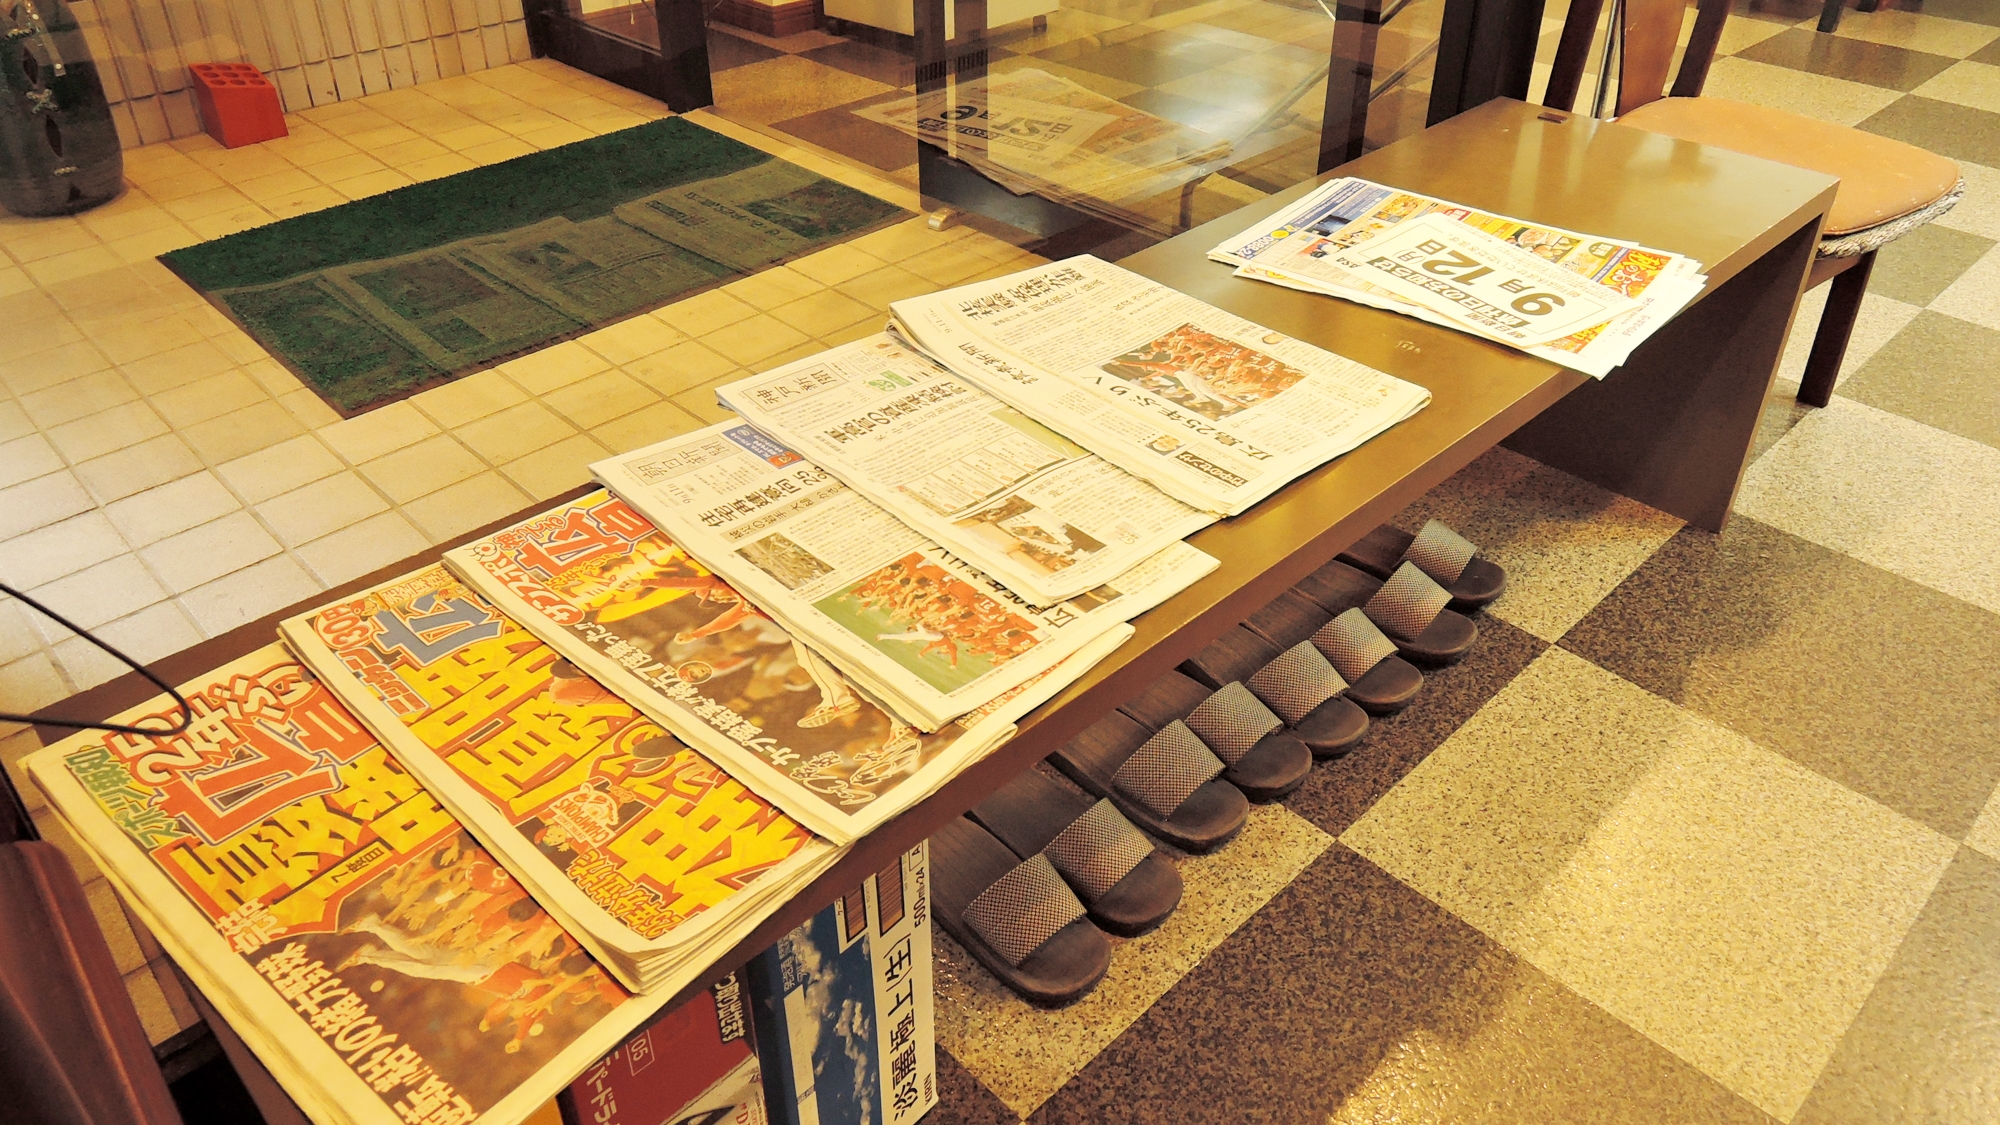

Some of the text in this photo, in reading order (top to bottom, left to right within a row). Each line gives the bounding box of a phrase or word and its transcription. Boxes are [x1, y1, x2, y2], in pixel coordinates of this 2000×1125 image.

[1334, 256, 1362, 269] ASA
[1412, 238, 1497, 286] 12日
[1371, 258, 1524, 326] 休刊日のお知らせ
[1496, 277, 1572, 318] 9月
[1462, 311, 1529, 339] 朝日新聞
[749, 368, 839, 405] 神戸新聞
[823, 380, 967, 443] 軍高官の資産凍結検討
[1078, 376, 1275, 463] 広島25年ぶりV
[637, 440, 729, 480] 朝日新聞
[694, 478, 802, 529] 住宅再建意向
[489, 512, 568, 550] 神ってる
[481, 556, 582, 624] サンスポ
[133, 663, 320, 785] 25年ぶり
[70, 743, 179, 849] スポーツ報知
[552, 799, 611, 843] CHAMPIONS
[330, 845, 387, 883] 7度目
[912, 846, 920, 857] A
[566, 849, 680, 939] 25年分泣けた
[586, 1061, 620, 1125] パードラ
[924, 1072, 935, 1106] KIRIN
